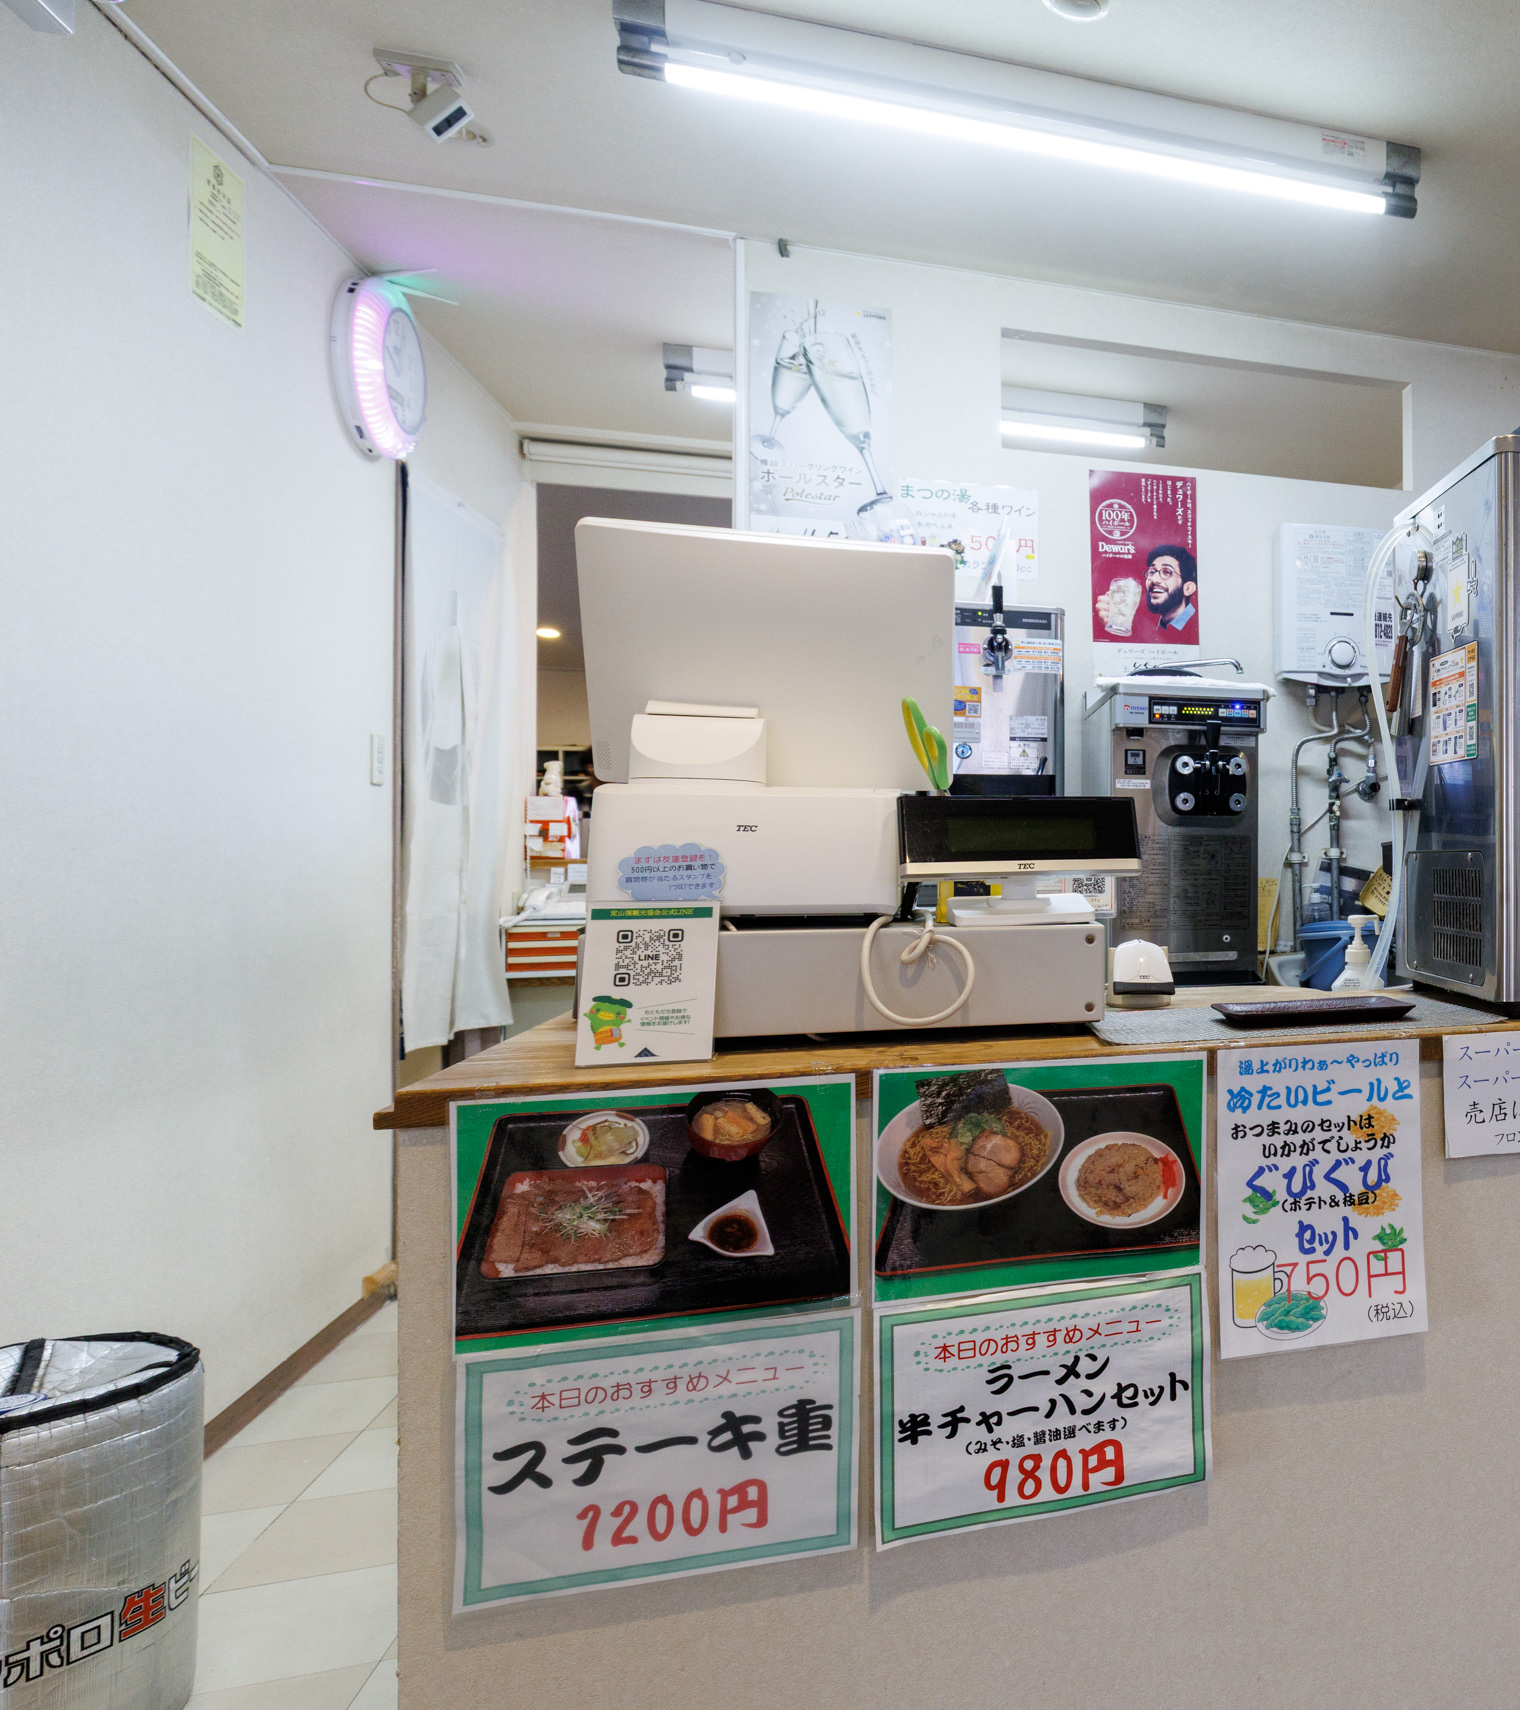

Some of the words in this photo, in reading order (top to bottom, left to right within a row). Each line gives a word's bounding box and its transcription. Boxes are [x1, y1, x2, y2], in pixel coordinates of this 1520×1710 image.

[783, 486, 841, 502] Polestar
[900, 484, 972, 504] まつの湯
[967, 500, 1037, 518] 各種ワイン
[1102, 510, 1131, 522] 100年
[970, 535, 1036, 554] 50円
[736, 824, 758, 833] TEC
[637, 953, 661, 961] LINE
[1225, 1076, 1415, 1114] 冷たいビールと
[1230, 1113, 1375, 1140] おつまみのセットは
[1262, 1131, 1397, 1159] いかがでしょうか
[1244, 1151, 1395, 1202] ぐびぐび
[1294, 1215, 1360, 1257] セット
[1275, 1248, 1407, 1305] 750円
[1366, 1299, 1415, 1325] （税込）
[933, 1317, 1163, 1364] 本日のおすすめメニュー
[530, 1364, 806, 1413] 本日のおすすめメニュー
[984, 1351, 1112, 1397] ラーメン
[896, 1370, 1192, 1447] 半チャーハンセット
[486, 1398, 835, 1496] ステーキ重
[982, 1437, 1126, 1504] 980円
[575, 1478, 770, 1552] 1200円
[0, 1558, 200, 1689] ポロ生ビ
